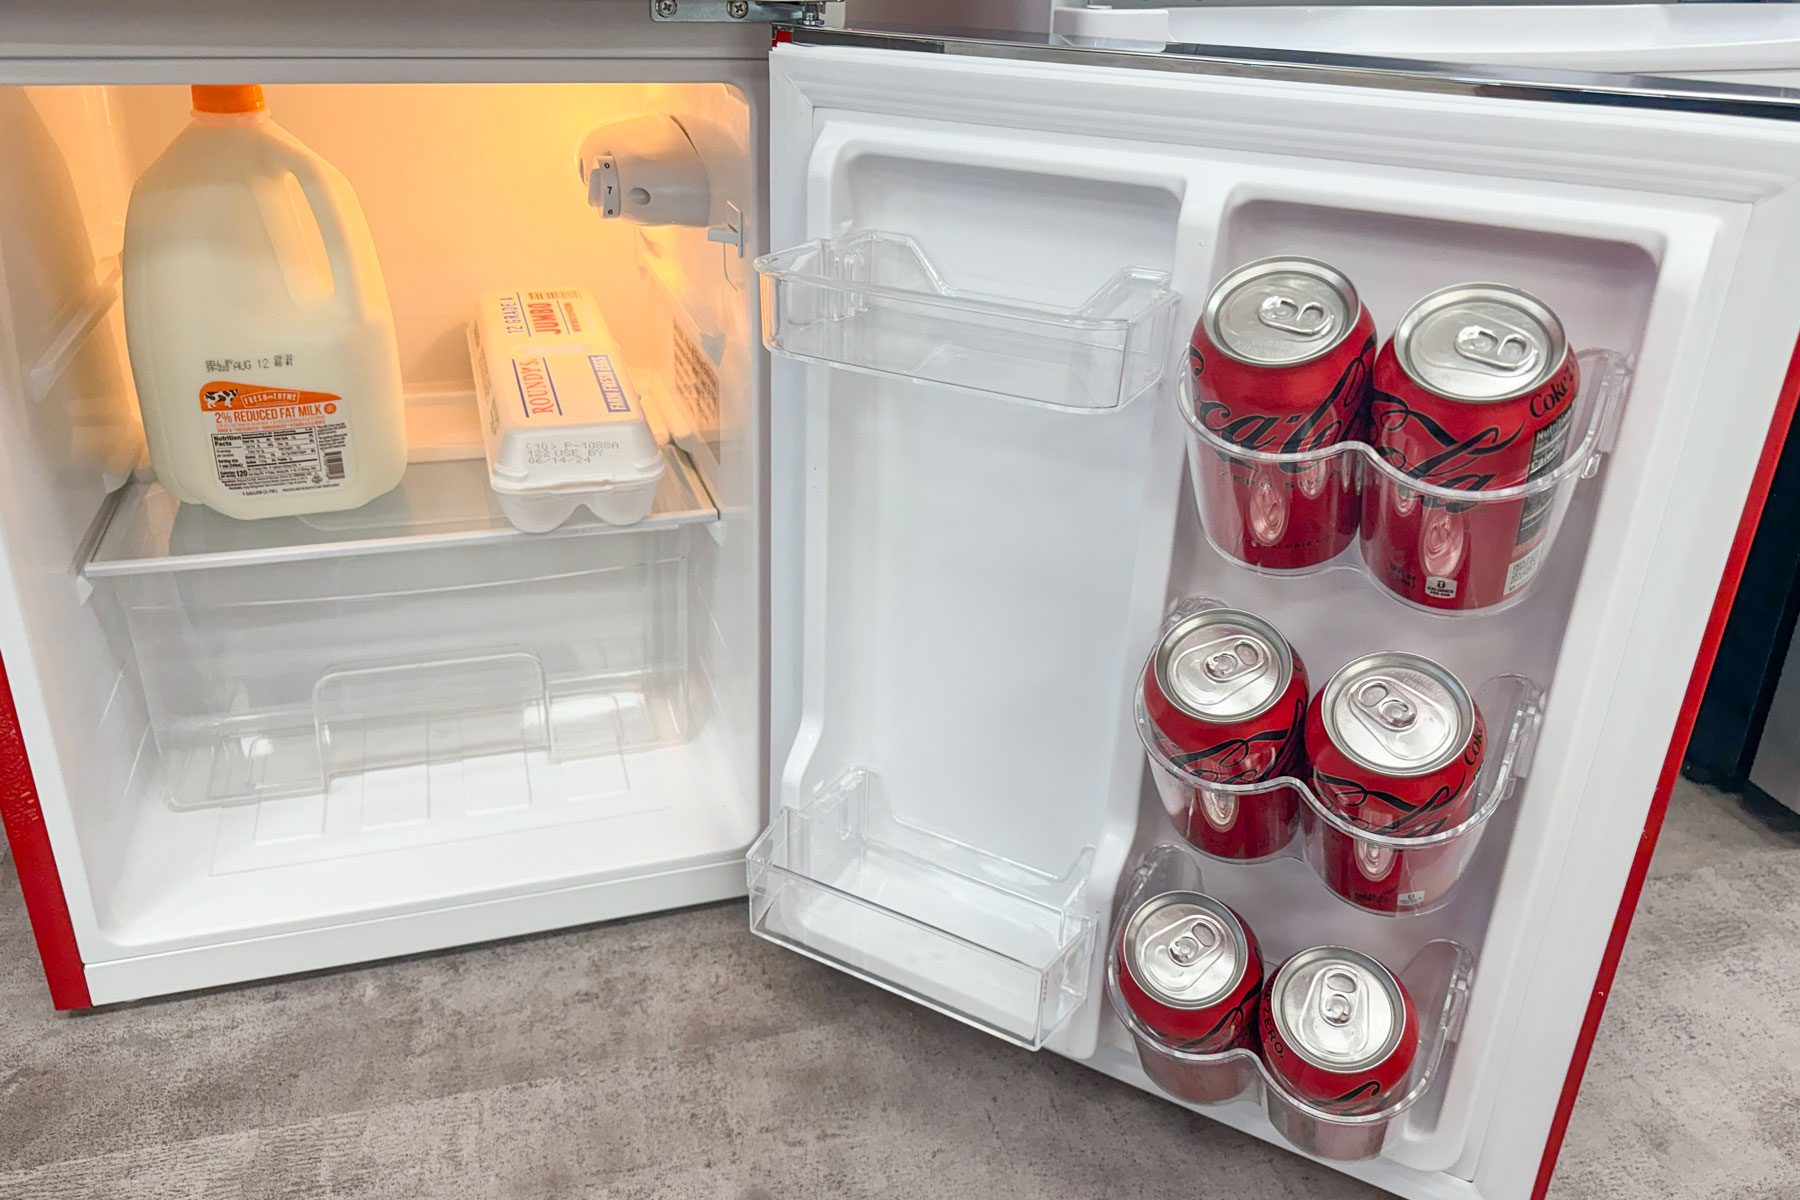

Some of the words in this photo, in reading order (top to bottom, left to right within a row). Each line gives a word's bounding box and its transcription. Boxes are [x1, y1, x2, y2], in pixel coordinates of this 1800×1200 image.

[500, 302, 521, 325] GRADE
[527, 302, 562, 335] JUMBO
[507, 325, 524, 334] 12
[233, 360, 252, 371] AUG
[257, 358, 270, 369] 12
[1529, 380, 1568, 418] Coke
[215, 411, 233, 423] 2%
[233, 408, 278, 422] REDUCED
[280, 406, 299, 419] FAT
[299, 404, 322, 417] MILK
[554, 449, 578, 457] USE
[588, 448, 604, 456] BY
[236, 469, 248, 477] 120
[1437, 580, 1446, 588] 0
